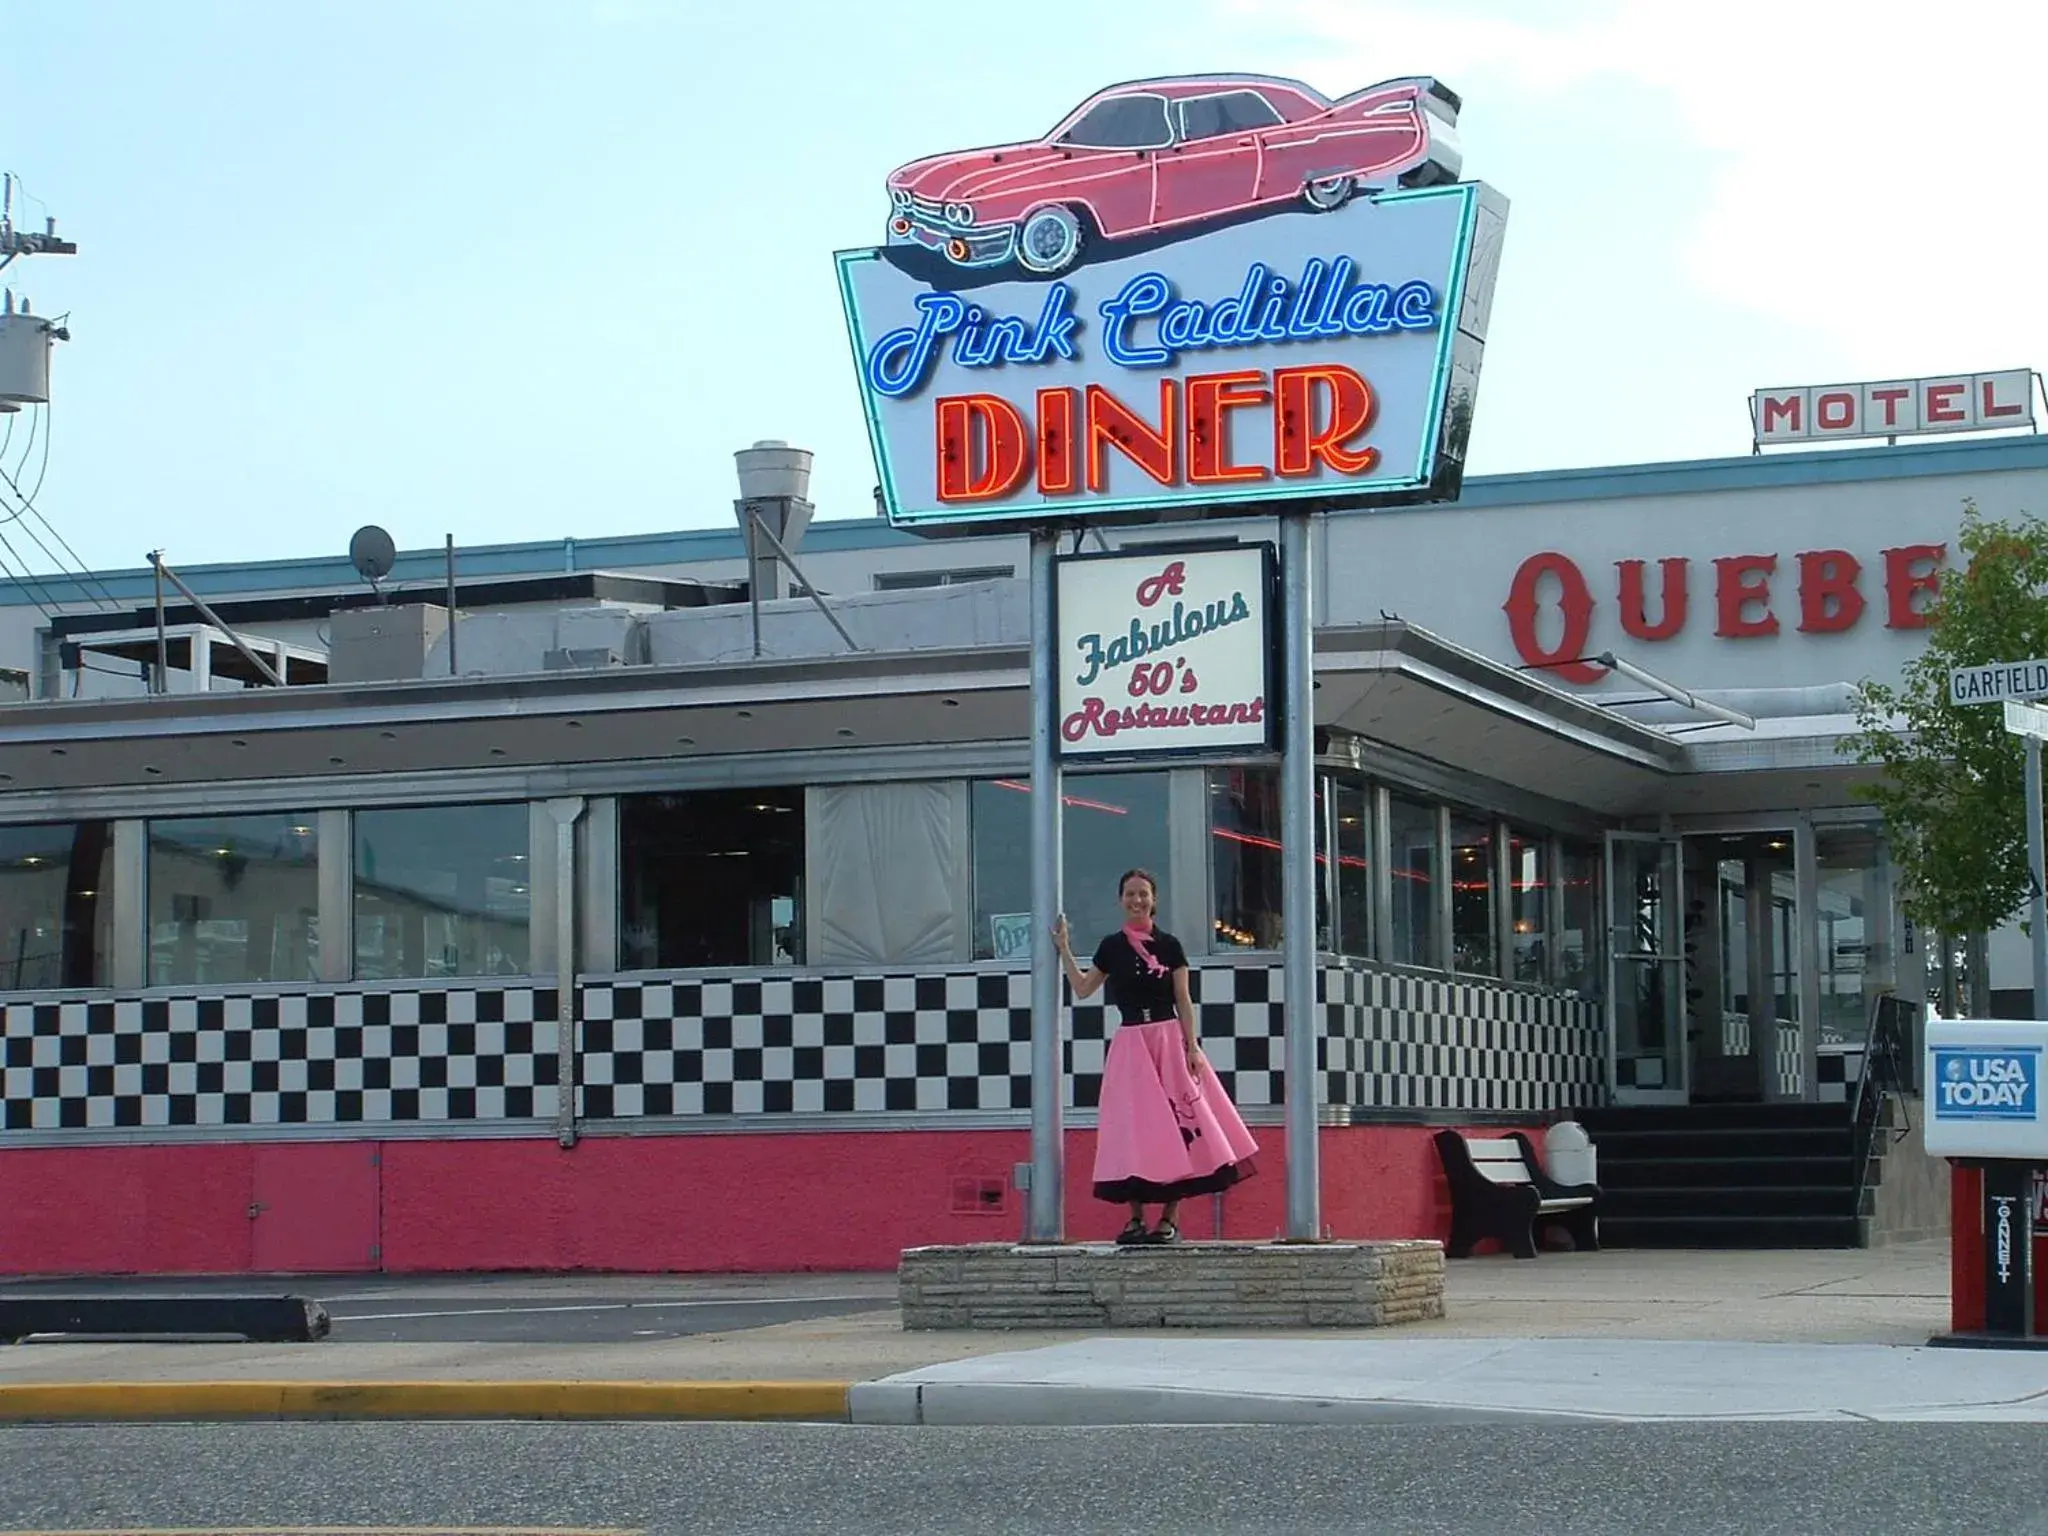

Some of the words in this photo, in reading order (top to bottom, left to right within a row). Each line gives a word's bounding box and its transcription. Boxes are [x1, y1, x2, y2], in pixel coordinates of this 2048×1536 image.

[867, 282, 1078, 396] Pink
[1100, 254, 1439, 366] Cadillac
[1764, 381, 2022, 432] MOTEL
[935, 365, 1378, 502] DINER
[1136, 561, 1185, 607] A
[1076, 592, 1250, 686] Fabulous
[1128, 656, 1198, 697] 50's
[1954, 665, 2048, 700] GARFIELD
[1062, 697, 1264, 742] Restaurant
[1969, 1059, 2026, 1082] USA
[1941, 1082, 2029, 1106] TODAY
[1998, 1205, 2011, 1284] GANNETT
